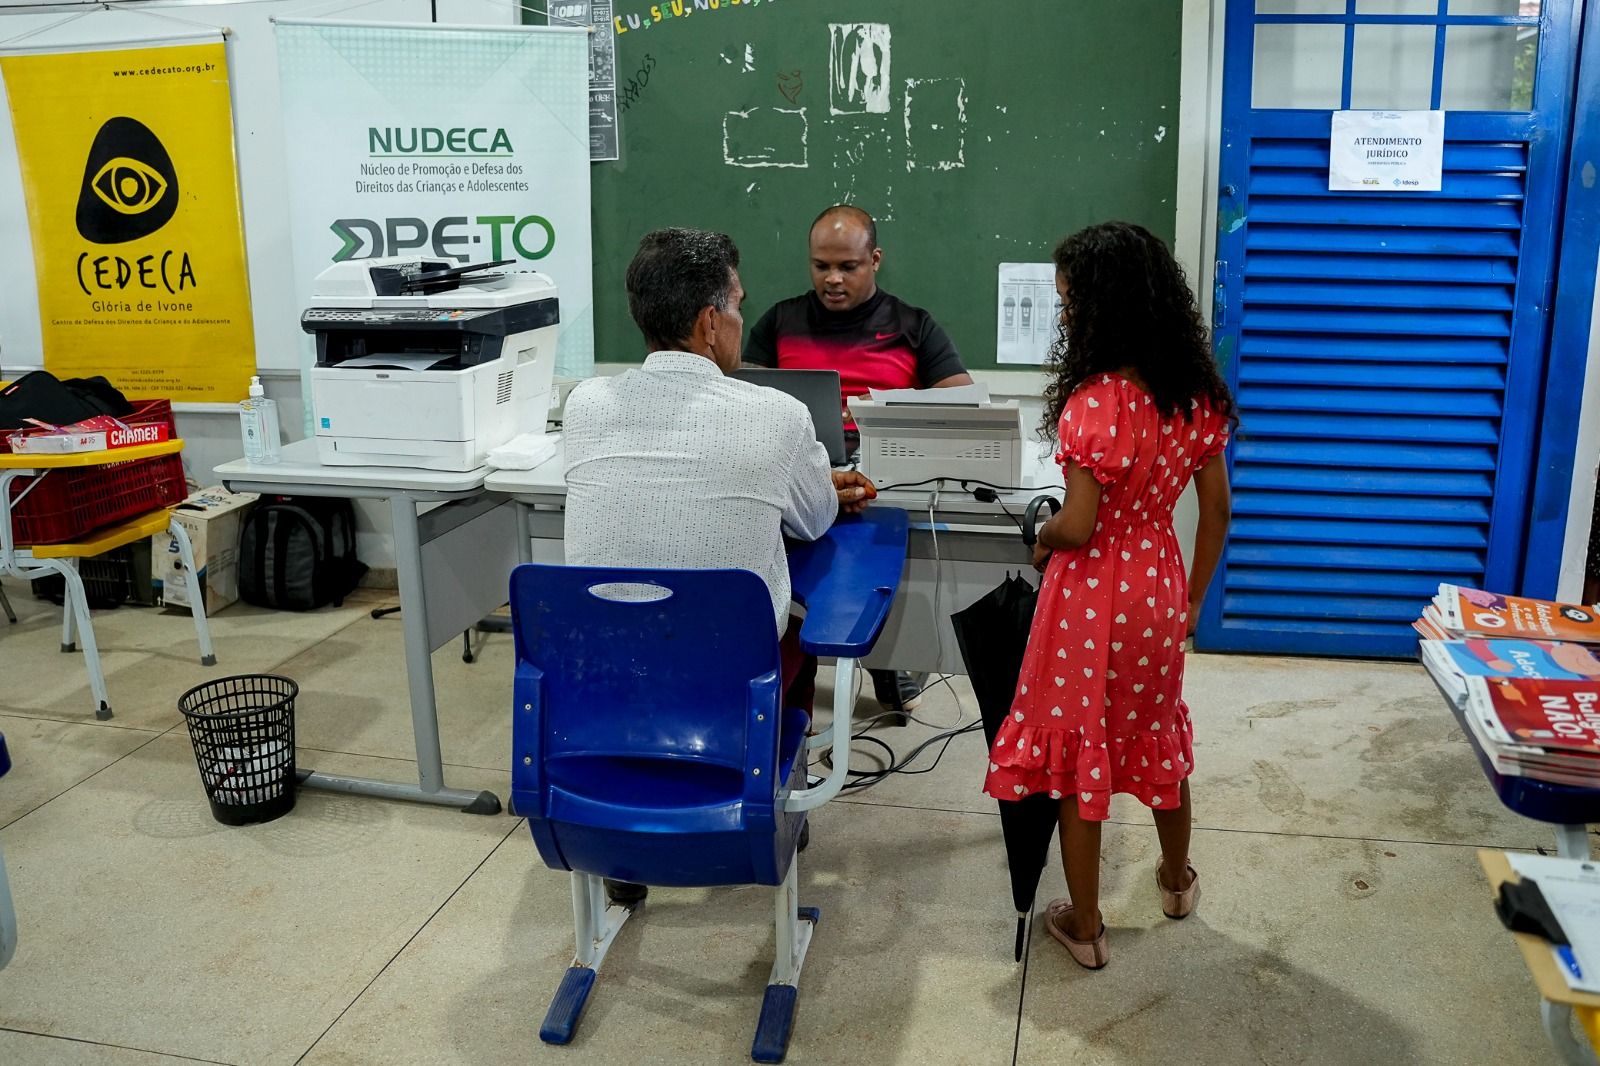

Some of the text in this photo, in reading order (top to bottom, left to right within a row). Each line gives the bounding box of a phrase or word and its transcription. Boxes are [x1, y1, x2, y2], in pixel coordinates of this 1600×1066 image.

[651, 0, 692, 22] SEU,
[113, 63, 216, 77] www.cedecato.org.br
[369, 127, 514, 153] NUDECA
[1354, 137, 1422, 146] ATENDIMENTO
[1366, 148, 1409, 159] JURÍDICO
[360, 162, 523, 178] Núcleo de Promoção e Defesa dos
[355, 179, 529, 195] Direitos das Crianças e Adolescentes
[77, 250, 197, 295] CEDECA
[92, 300, 194, 313] Glória de Ivone
[153, 318, 176, 326] Criança
[111, 426, 159, 446] CHAMEX
[1538, 695, 1588, 740] NÃO!
